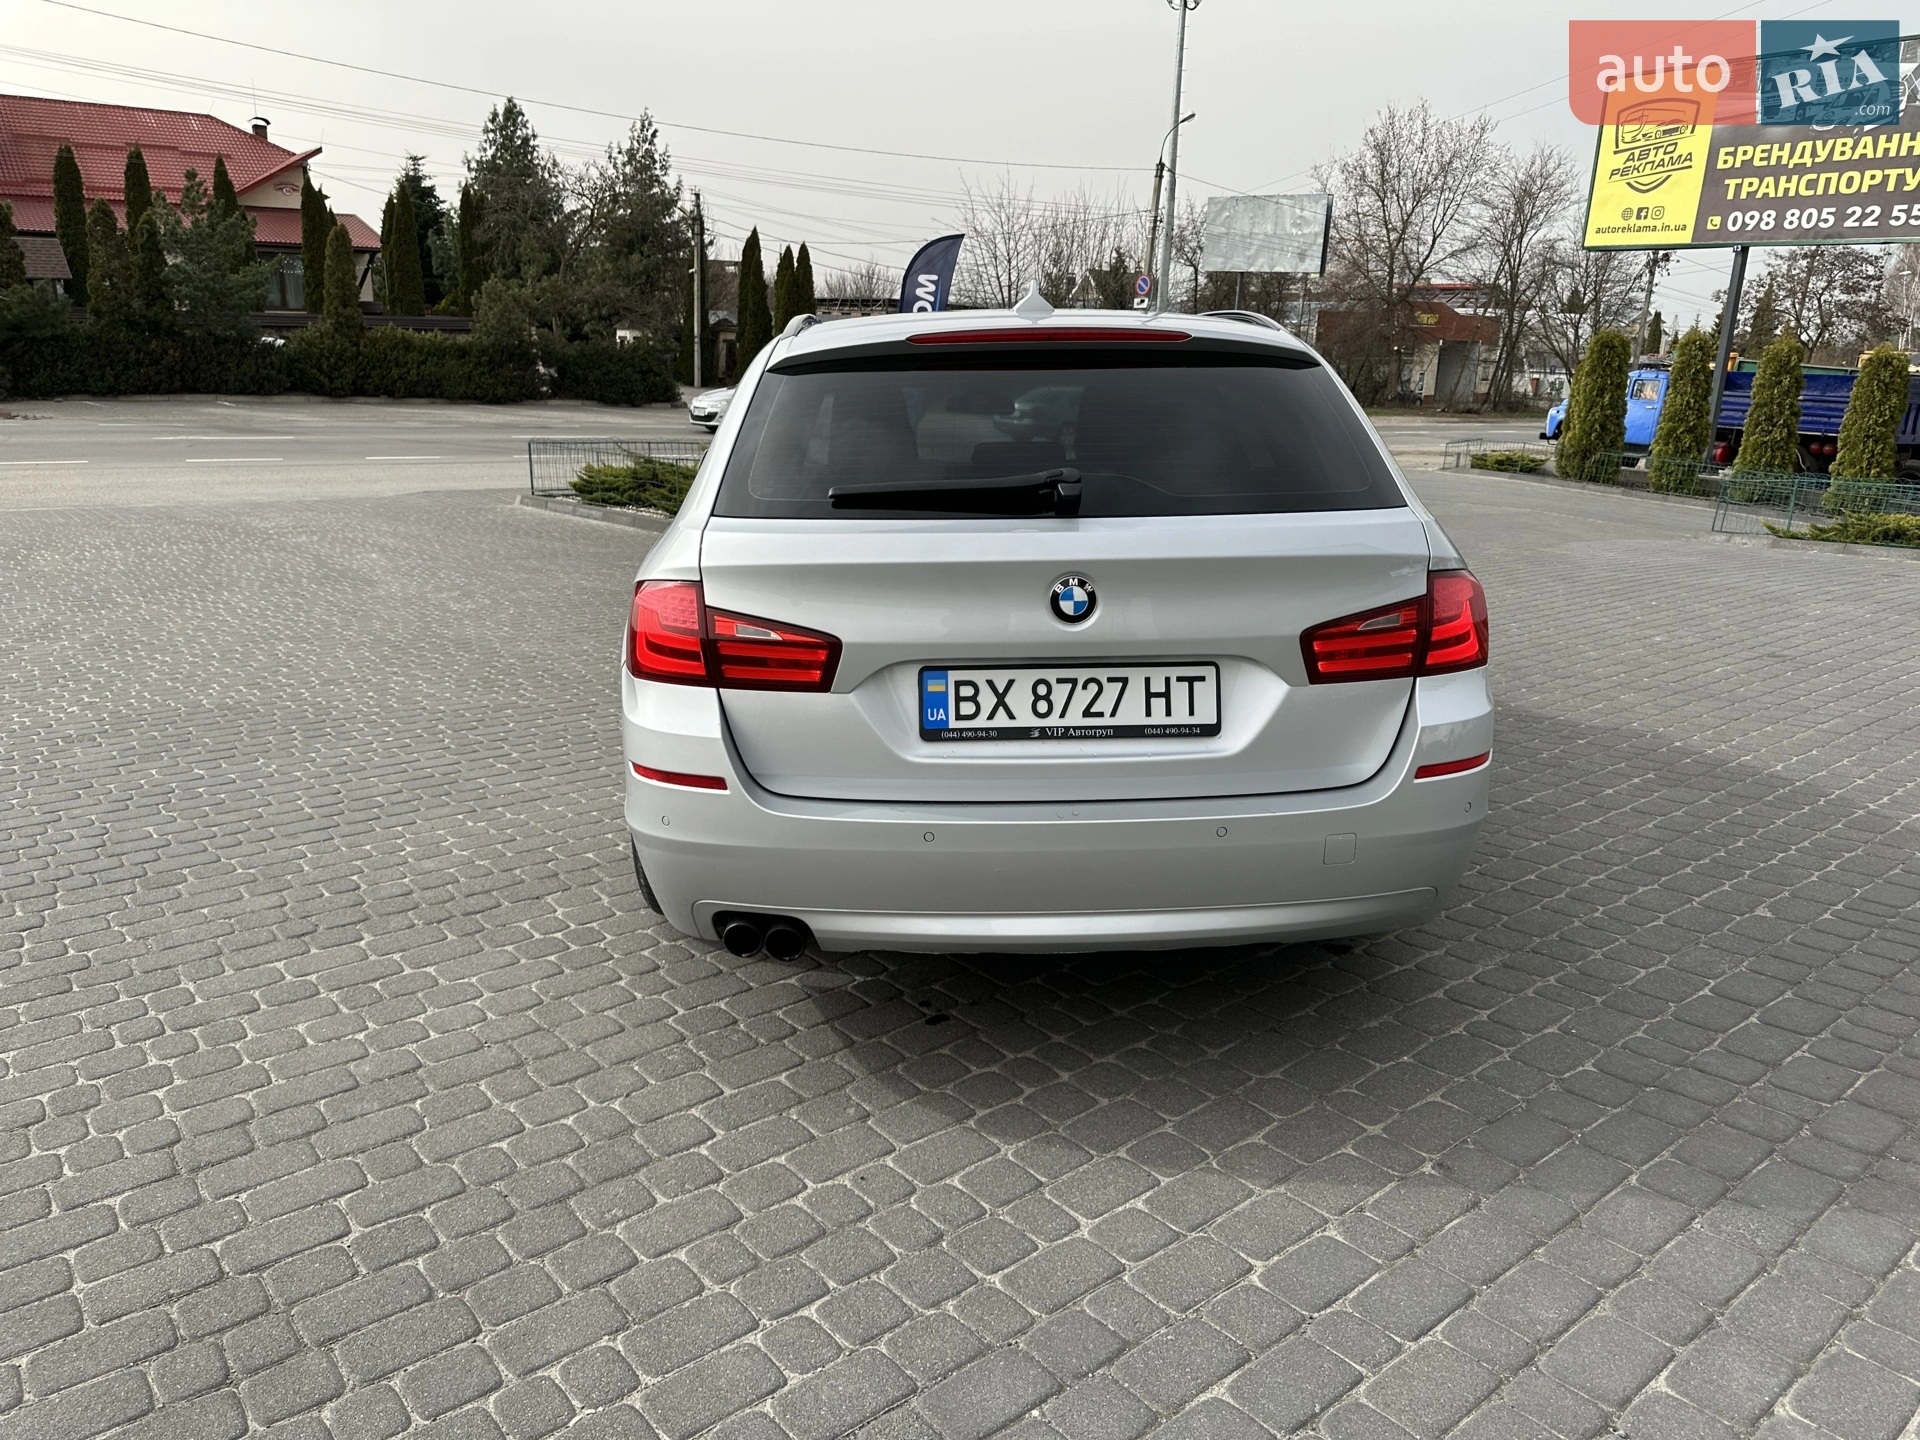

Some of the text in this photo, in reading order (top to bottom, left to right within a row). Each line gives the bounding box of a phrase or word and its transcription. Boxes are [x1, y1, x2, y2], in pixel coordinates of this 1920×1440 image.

[1623, 142, 1678, 165] АВТО
[1609, 152, 1693, 180] РЕКЛАМА
[1724, 167, 1920, 200] ТРАНСПОРТУ
[1727, 203, 1920, 232] 098 805 22 55
[1595, 222, 1687, 234] autoreklama.in.ua
[1054, 578, 1094, 594] BMW
[953, 675, 1206, 721] BX 8727 HT
[927, 708, 947, 721] UA
[941, 730, 998, 739] (044) 490-94-30
[1045, 727, 1114, 738] VIP Автогруп
[1144, 726, 1201, 735] (044) 490-94-34
